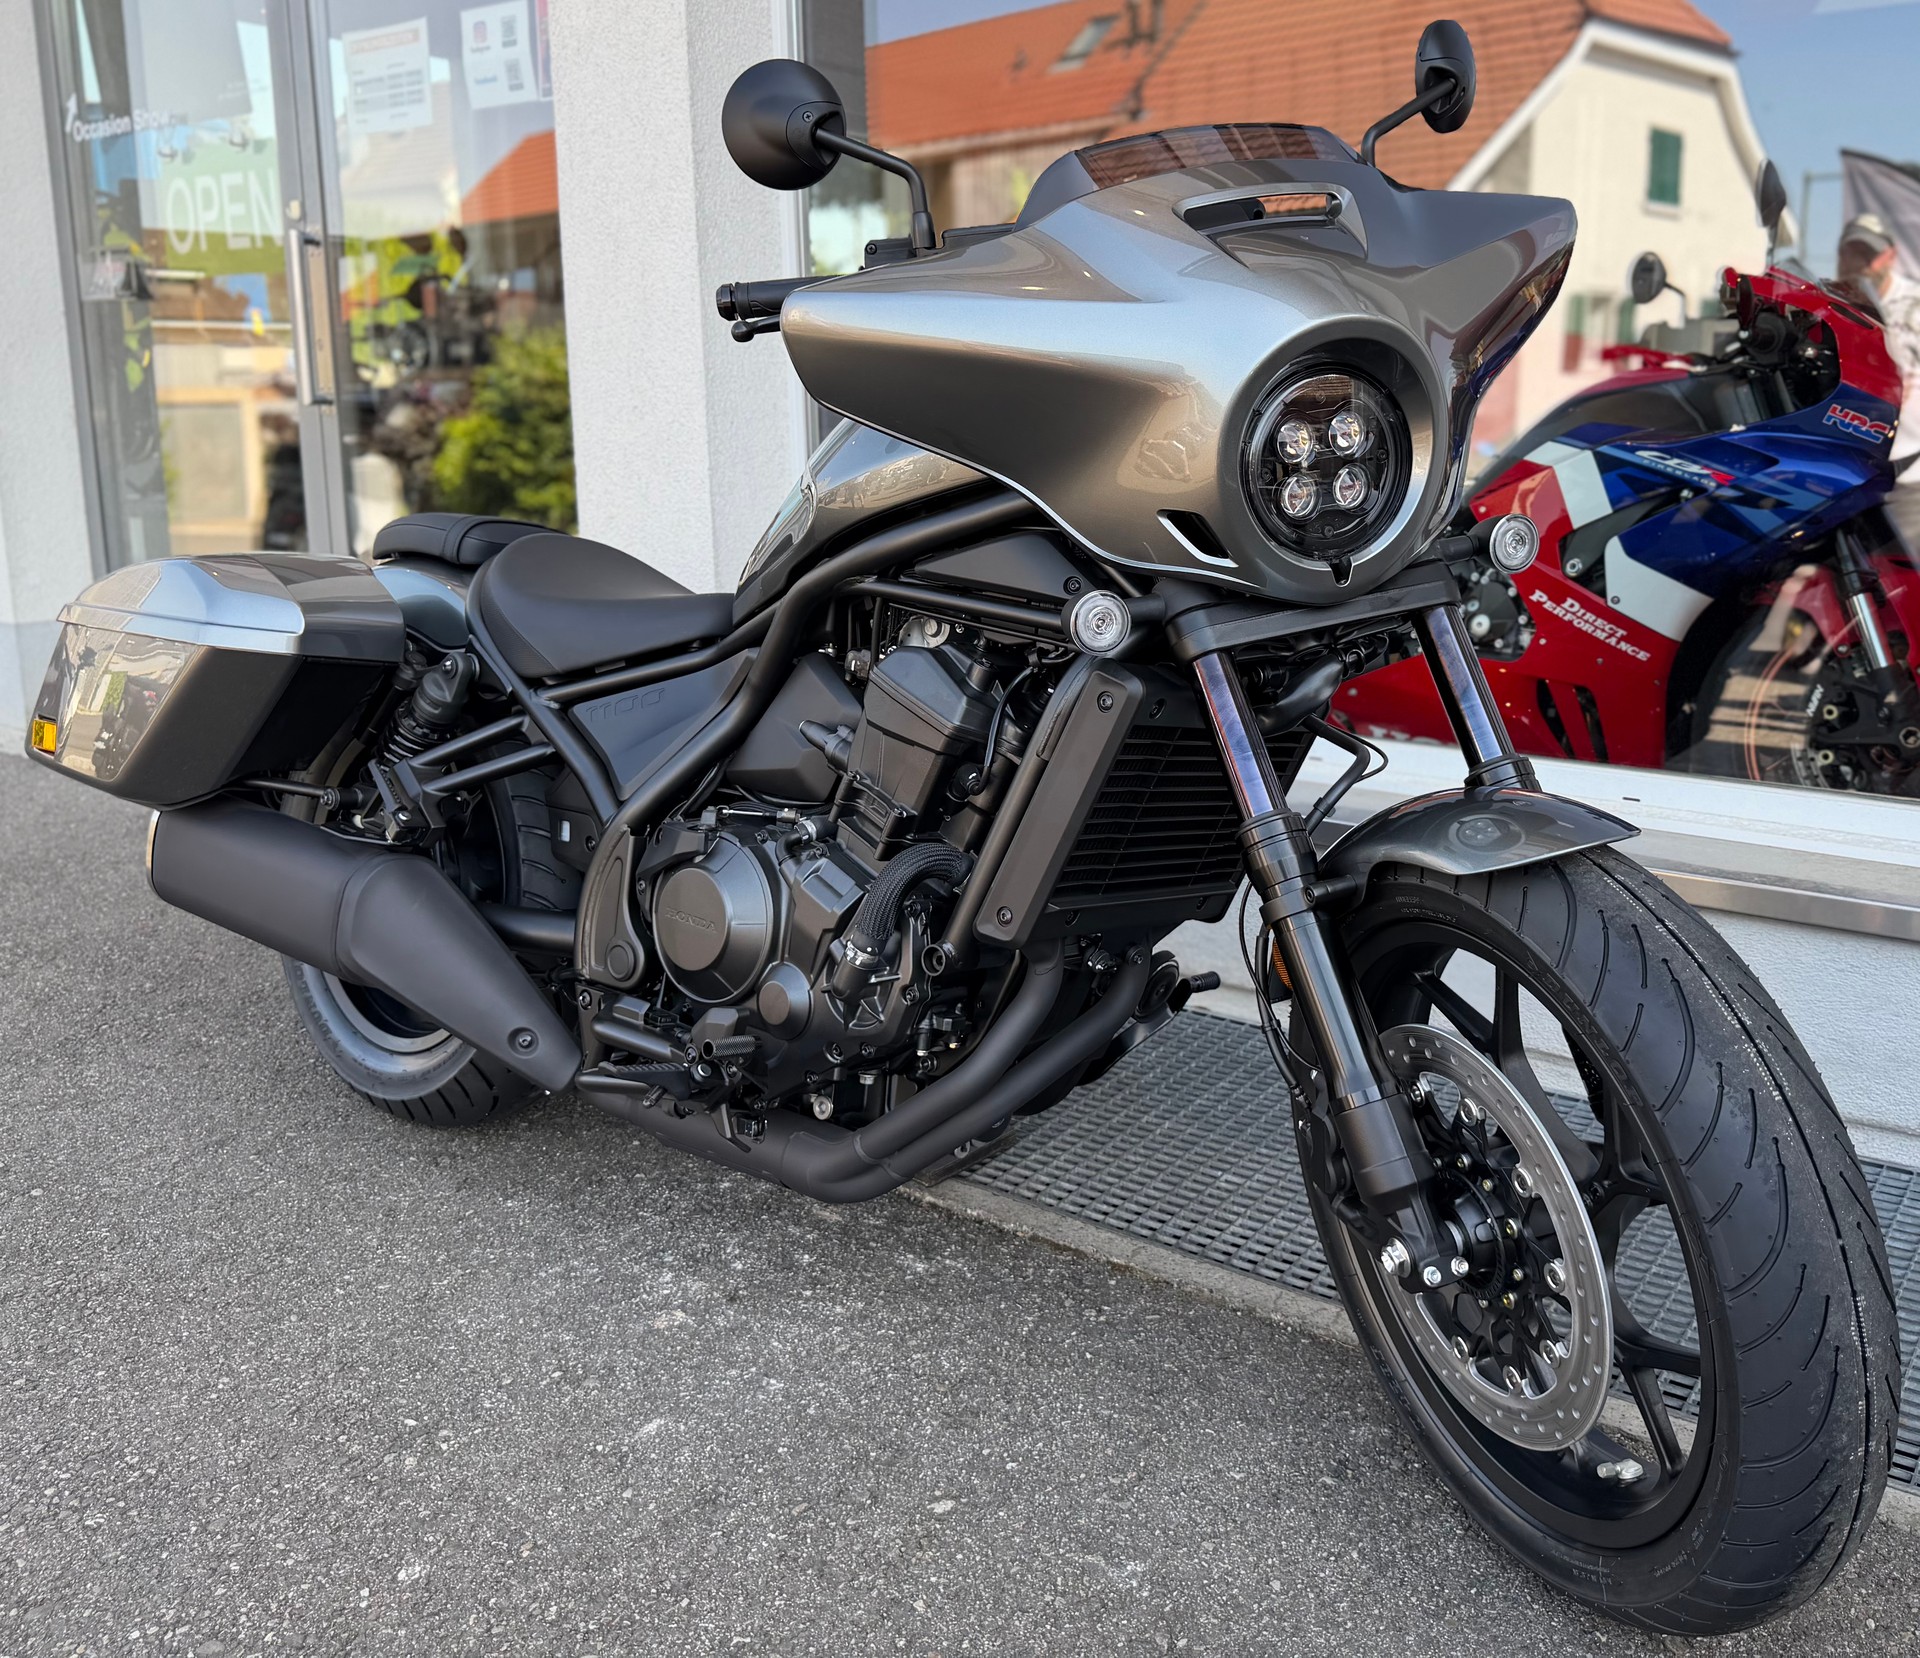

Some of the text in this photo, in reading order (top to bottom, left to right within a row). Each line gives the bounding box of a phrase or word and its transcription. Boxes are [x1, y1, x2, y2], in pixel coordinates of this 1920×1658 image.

[72, 113, 132, 142] Occasion
[166, 168, 284, 254] OPEN
[1823, 403, 1891, 444] HRC
[1528, 589, 1651, 662] PERFORMANCE
[1560, 597, 1628, 638] DIRECT
[585, 687, 665, 722] 1100
[664, 906, 718, 934] HONDA
